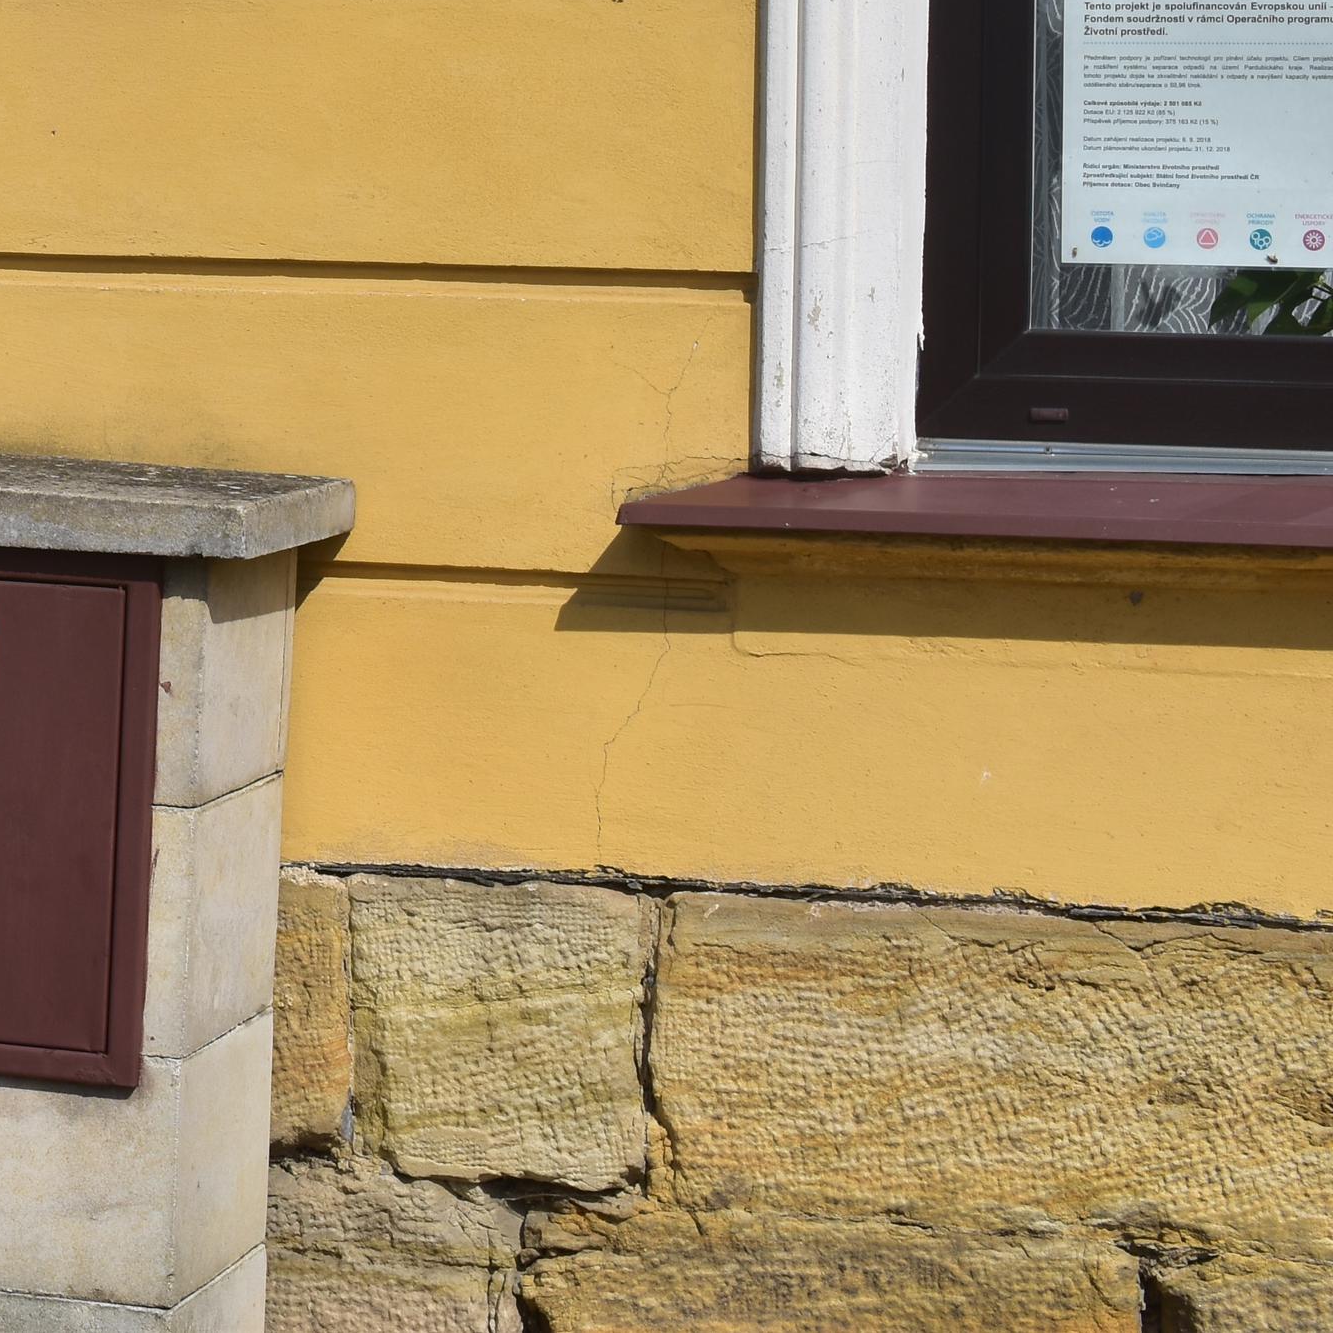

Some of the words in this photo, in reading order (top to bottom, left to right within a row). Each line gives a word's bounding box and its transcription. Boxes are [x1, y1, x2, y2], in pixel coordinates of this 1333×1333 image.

[1084, 1, 1112, 11] Tento
[1115, 1, 1149, 13] projekt
[1151, 1, 1161, 13] je
[1164, 1, 1247, 13] spolufinancován
[1250, 2, 1305, 13] Evropskou
[1308, 2, 1327, 11] unií
[1084, 14, 1124, 24] Fondem
[1126, 14, 1185, 24] soudržnosti
[1188, 16, 1193, 24] v
[1196, 14, 1224, 24] rámci
[1226, 14, 1285, 25] Operačního
[1083, 26, 1118, 37] Životní
[1120, 26, 1169, 39] prostředí.
